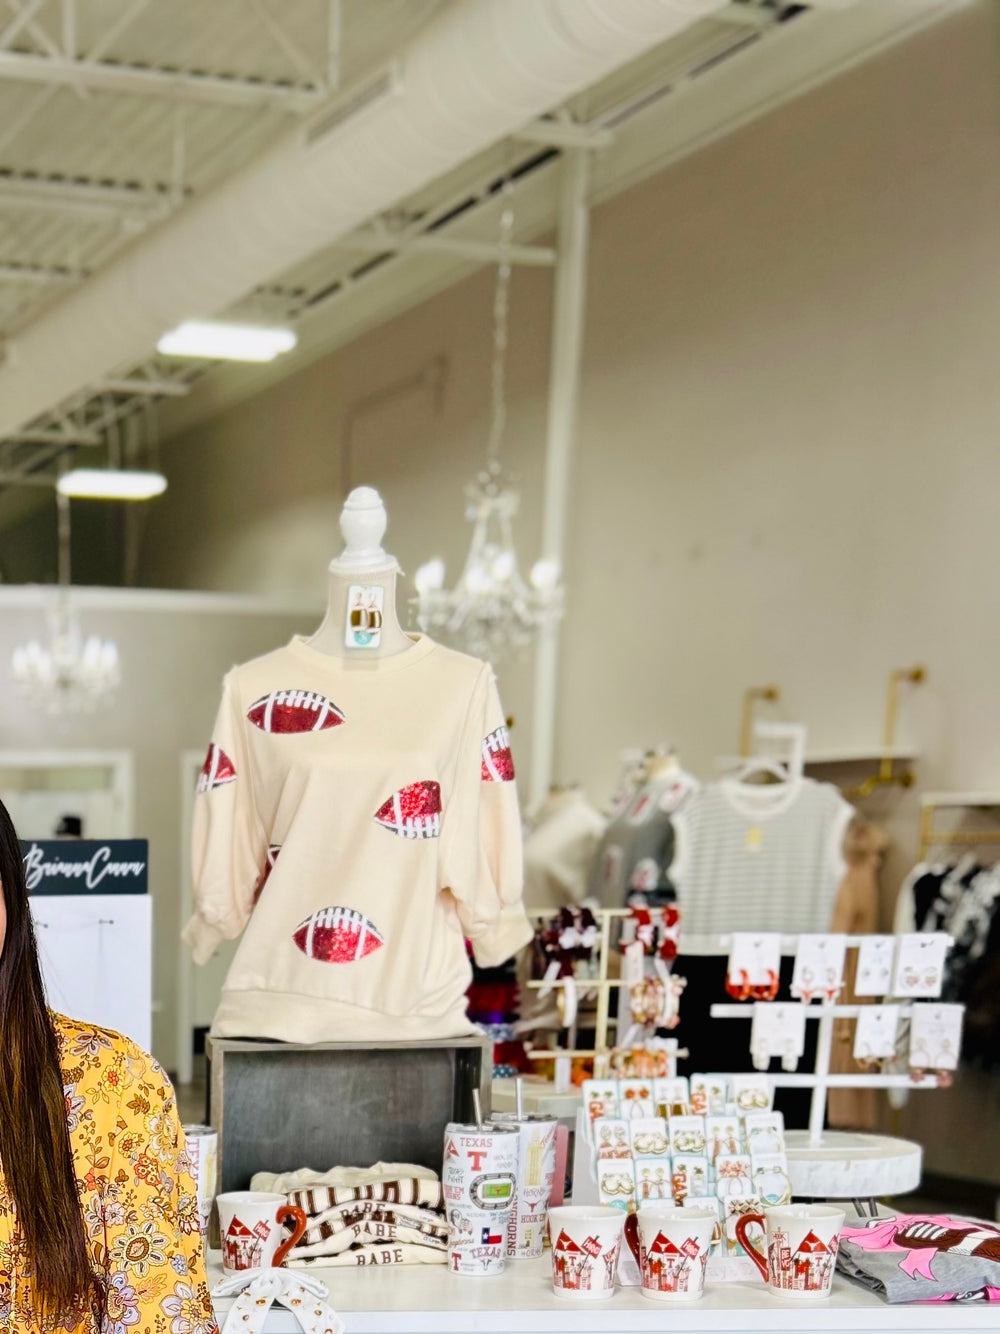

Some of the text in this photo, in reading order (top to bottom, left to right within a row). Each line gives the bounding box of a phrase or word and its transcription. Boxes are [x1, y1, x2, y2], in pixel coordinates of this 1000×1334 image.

[460, 1137, 493, 1148] TEXAS
[467, 1151, 487, 1172] T
[352, 1222, 397, 1238] BABE
[356, 1249, 404, 1266] BABE
[470, 1247, 502, 1259] TEXAS
[451, 1252, 462, 1271] T
